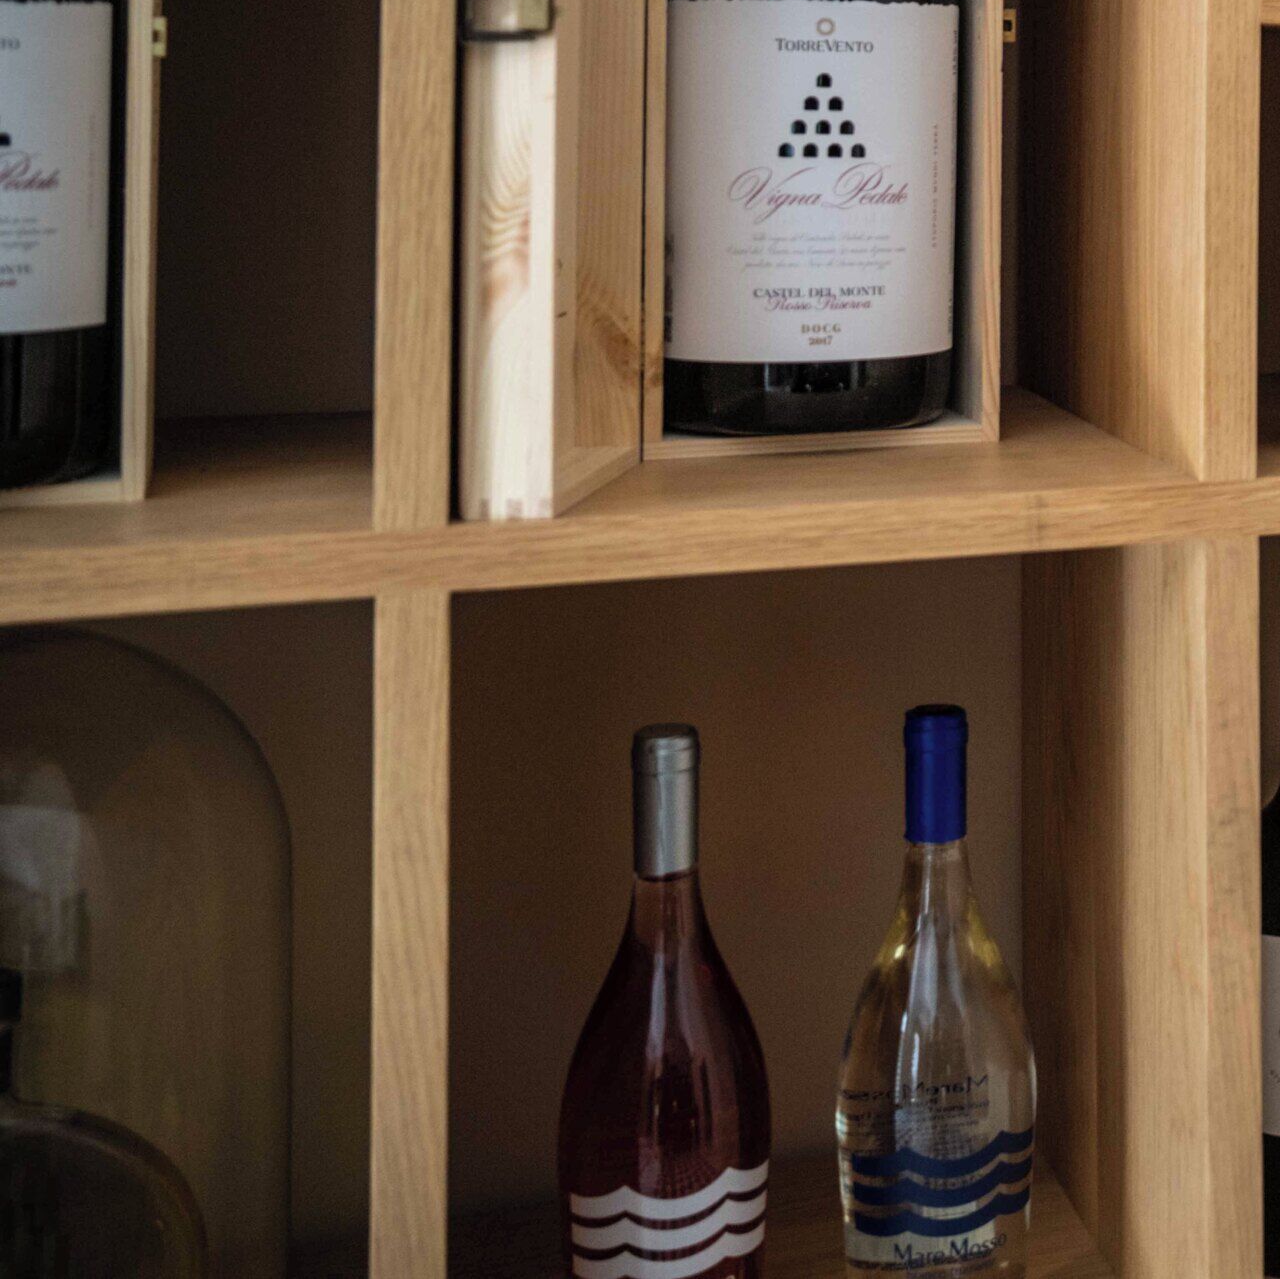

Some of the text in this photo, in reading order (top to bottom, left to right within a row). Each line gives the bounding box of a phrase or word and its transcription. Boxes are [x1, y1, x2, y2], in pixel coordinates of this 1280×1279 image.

[729, 166, 822, 224] Vigna
[753, 285, 885, 298] CASTEL DEL MONTE
